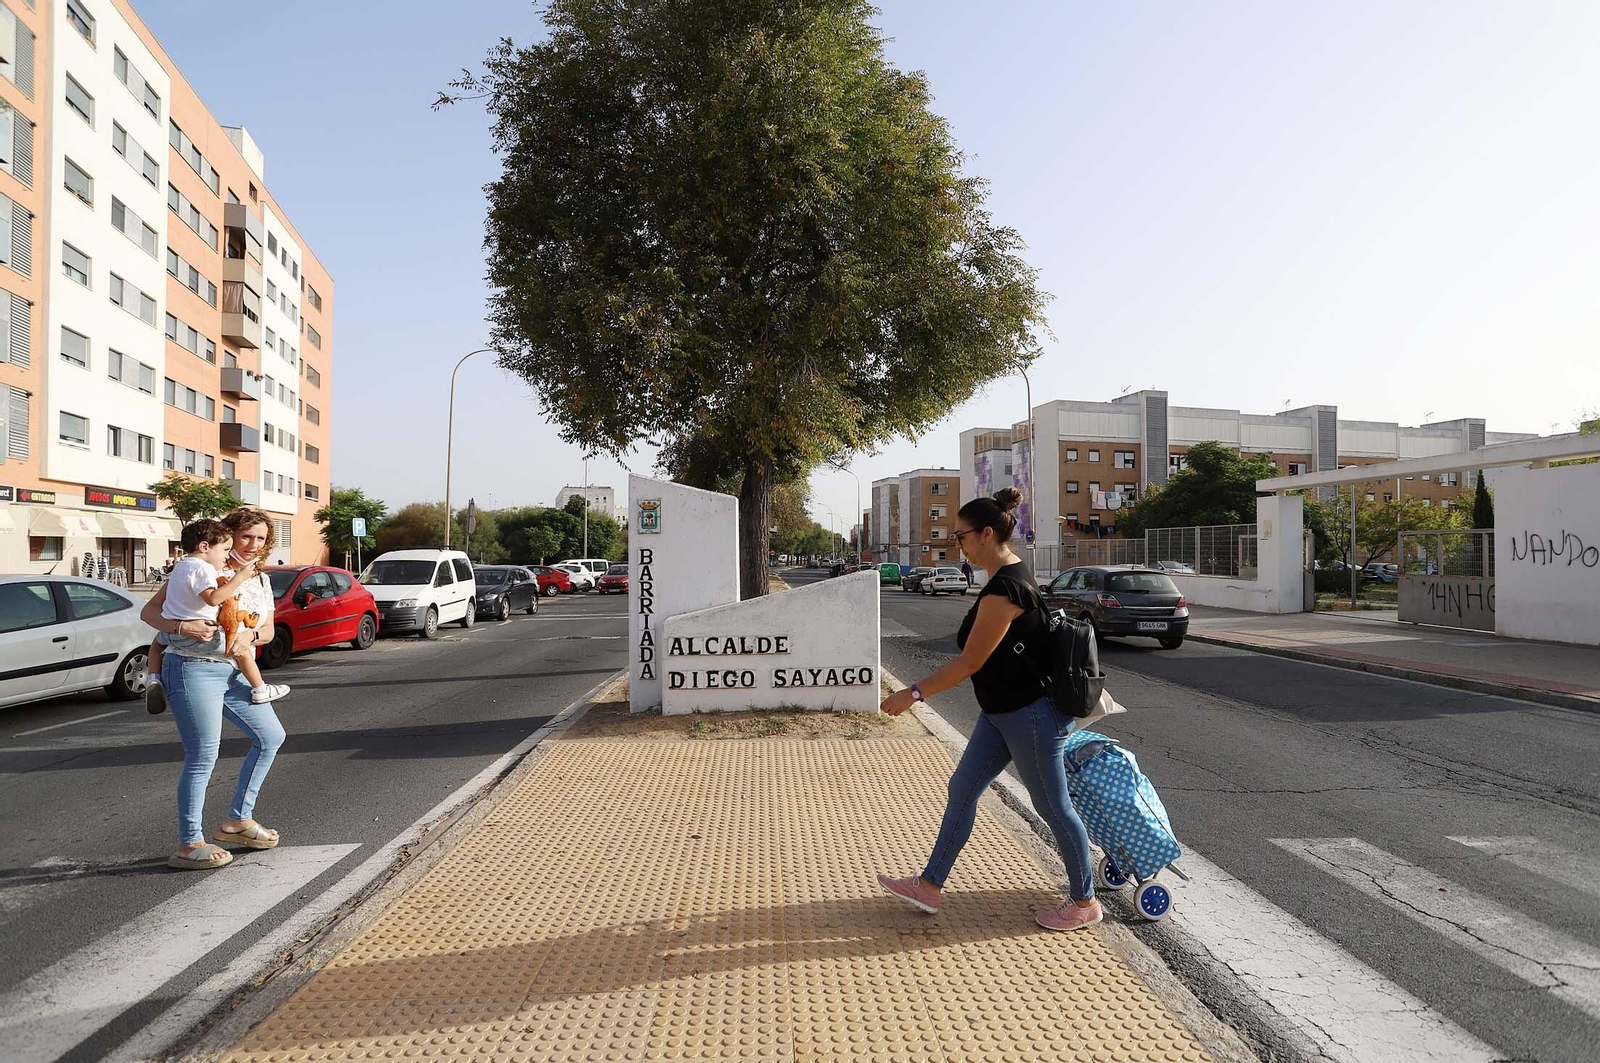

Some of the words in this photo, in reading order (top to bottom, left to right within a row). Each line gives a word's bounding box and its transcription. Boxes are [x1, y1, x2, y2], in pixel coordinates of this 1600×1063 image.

[89, 491, 110, 503] JUEGOS
[113, 494, 136, 507] APUESTAS
[1512, 529, 1599, 567] NANDO
[639, 549, 654, 679] BARRIADA
[669, 637, 789, 655] ALCALDE
[669, 670, 755, 689] DIEGO
[773, 667, 873, 687] SAYAGO
